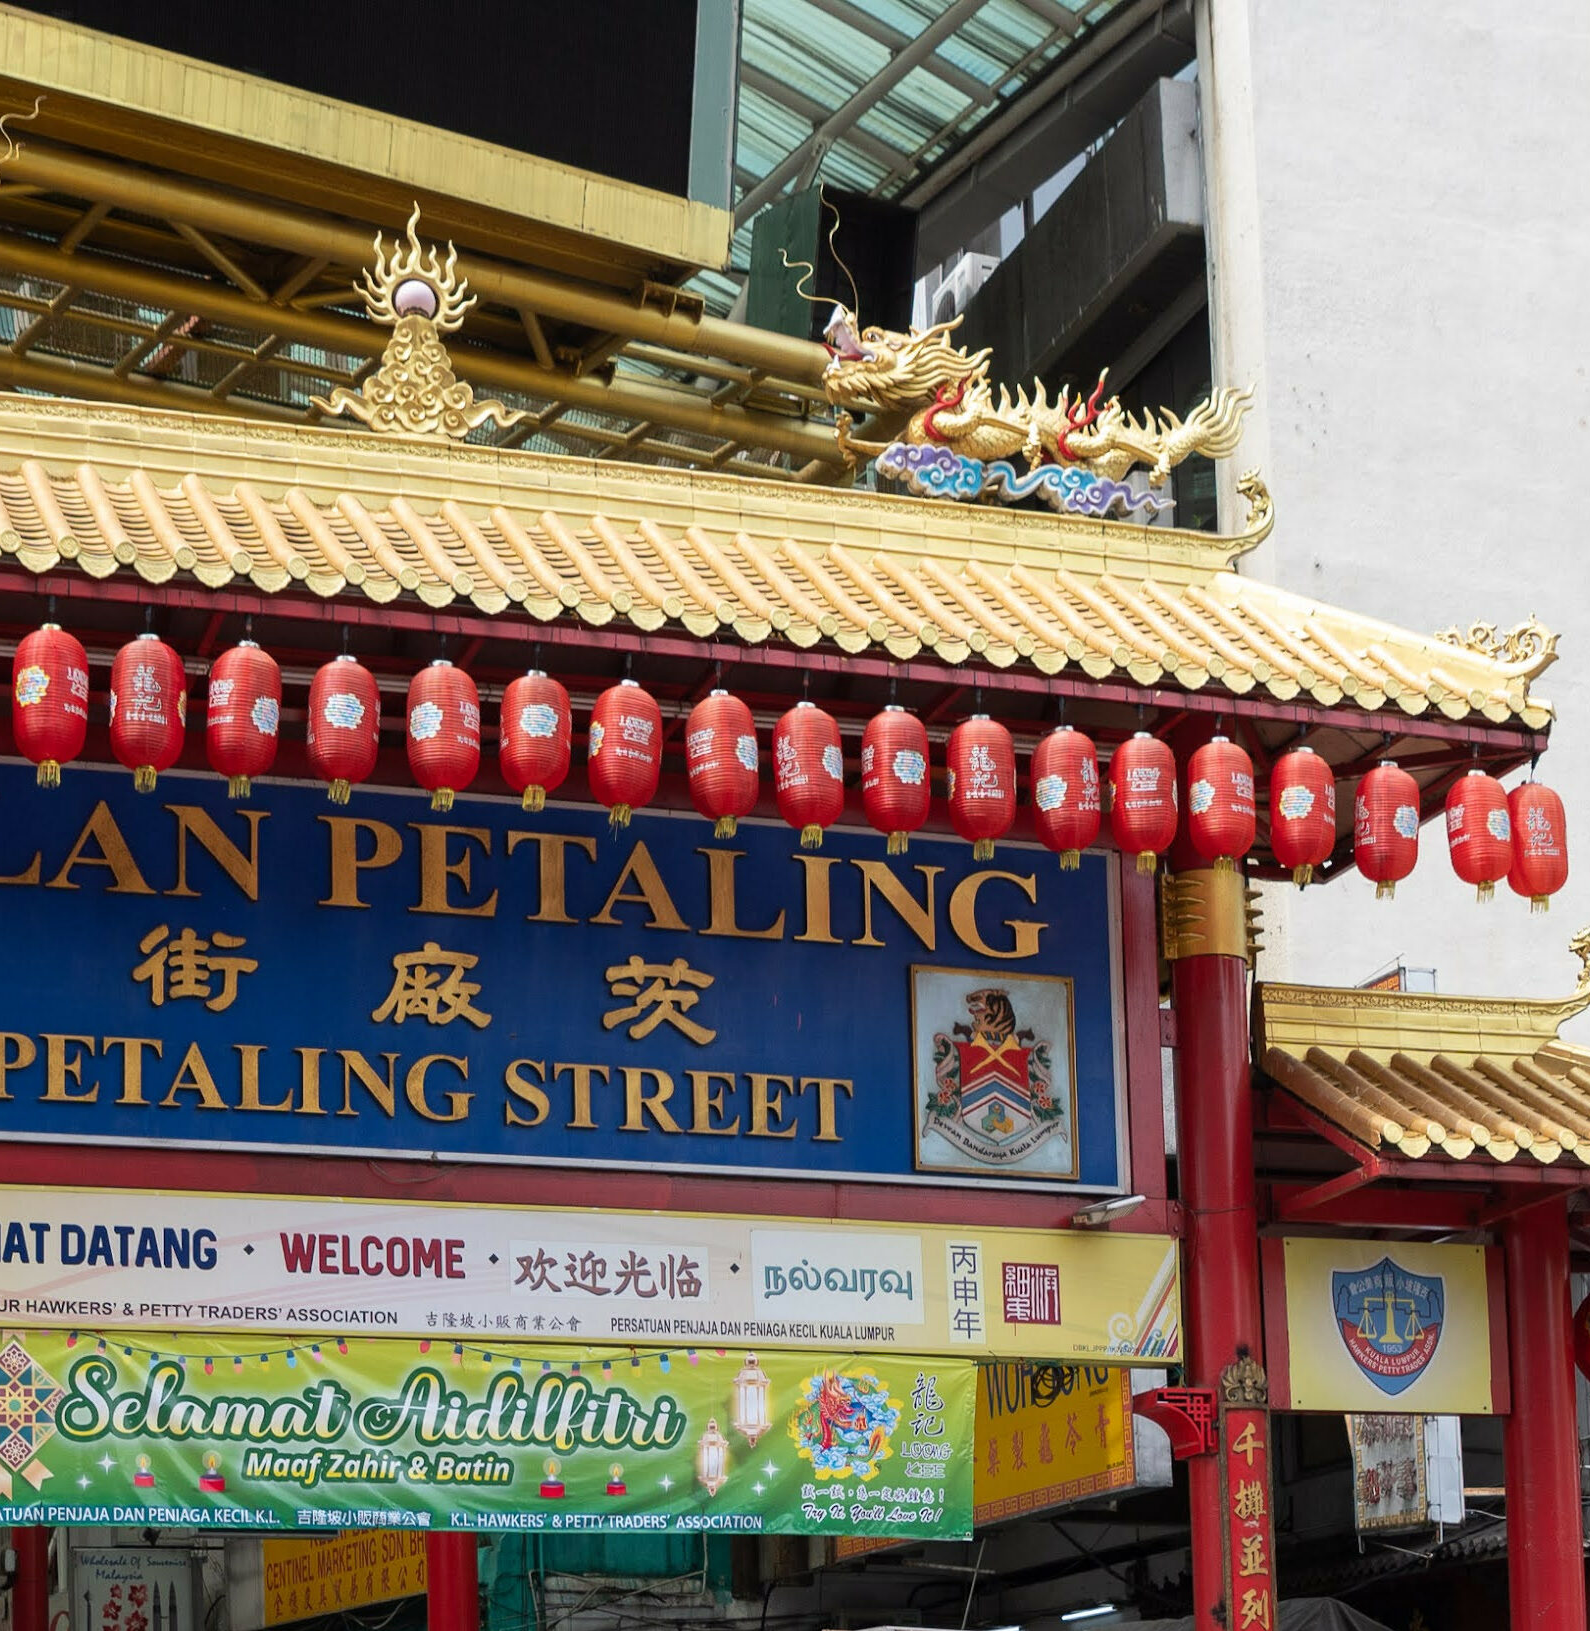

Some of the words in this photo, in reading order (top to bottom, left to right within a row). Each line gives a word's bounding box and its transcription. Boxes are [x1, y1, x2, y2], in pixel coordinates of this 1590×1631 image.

[317, 815, 1049, 959] PETALING
[504, 1058, 854, 1143] STREET
[933, 1116, 961, 1140] Dewan
[1009, 1141, 1031, 1157] Kuala
[59, 1223, 218, 1272] DATANG
[280, 1231, 466, 1280] WELCOME
[514, 1249, 703, 1301] 欢迎光临
[764, 1261, 913, 1301] நல்வரவு
[950, 1245, 982, 1340] 丙申年
[122, 1301, 135, 1317] &
[140, 1302, 194, 1319] PETTY
[286, 1306, 399, 1325] ASSOCIATION
[424, 1311, 582, 1334] 吉隆坡小販商業公會
[610, 1316, 671, 1335] PERSATUAN
[673, 1318, 720, 1337] PENJAJA
[721, 1320, 742, 1336] DAN
[743, 1320, 788, 1338] PENIAGA
[789, 1322, 819, 1339] KECIL
[819, 1323, 854, 1341] KUALA
[854, 1324, 896, 1342] LUMPUR
[60, 1355, 352, 1441] Selamat
[360, 1369, 685, 1450] Aidilfitri
[910, 1372, 945, 1437] 龍記
[246, 1452, 322, 1484] Maaf
[323, 1450, 401, 1482] Zahir
[408, 1455, 428, 1481] &
[436, 1454, 510, 1483] Batin
[48, 1506, 111, 1525] PENJAJA
[114, 1507, 146, 1523] DAN
[149, 1507, 211, 1525] PENIAGA
[213, 1508, 254, 1525] KECIL
[255, 1508, 281, 1525] K.L.
[451, 1512, 475, 1528] K.L.
[551, 1513, 562, 1529] &
[564, 1512, 604, 1530] PETTY
[675, 1513, 763, 1531] ASSOCIATION
[802, 1504, 827, 1522] Try
[885, 1507, 917, 1523] Love
[919, 1507, 943, 1523] It!
[95, 1569, 144, 1584] Malaysia
[266, 1554, 314, 1591] CENTINEL
[317, 1538, 377, 1580] MARKETING
